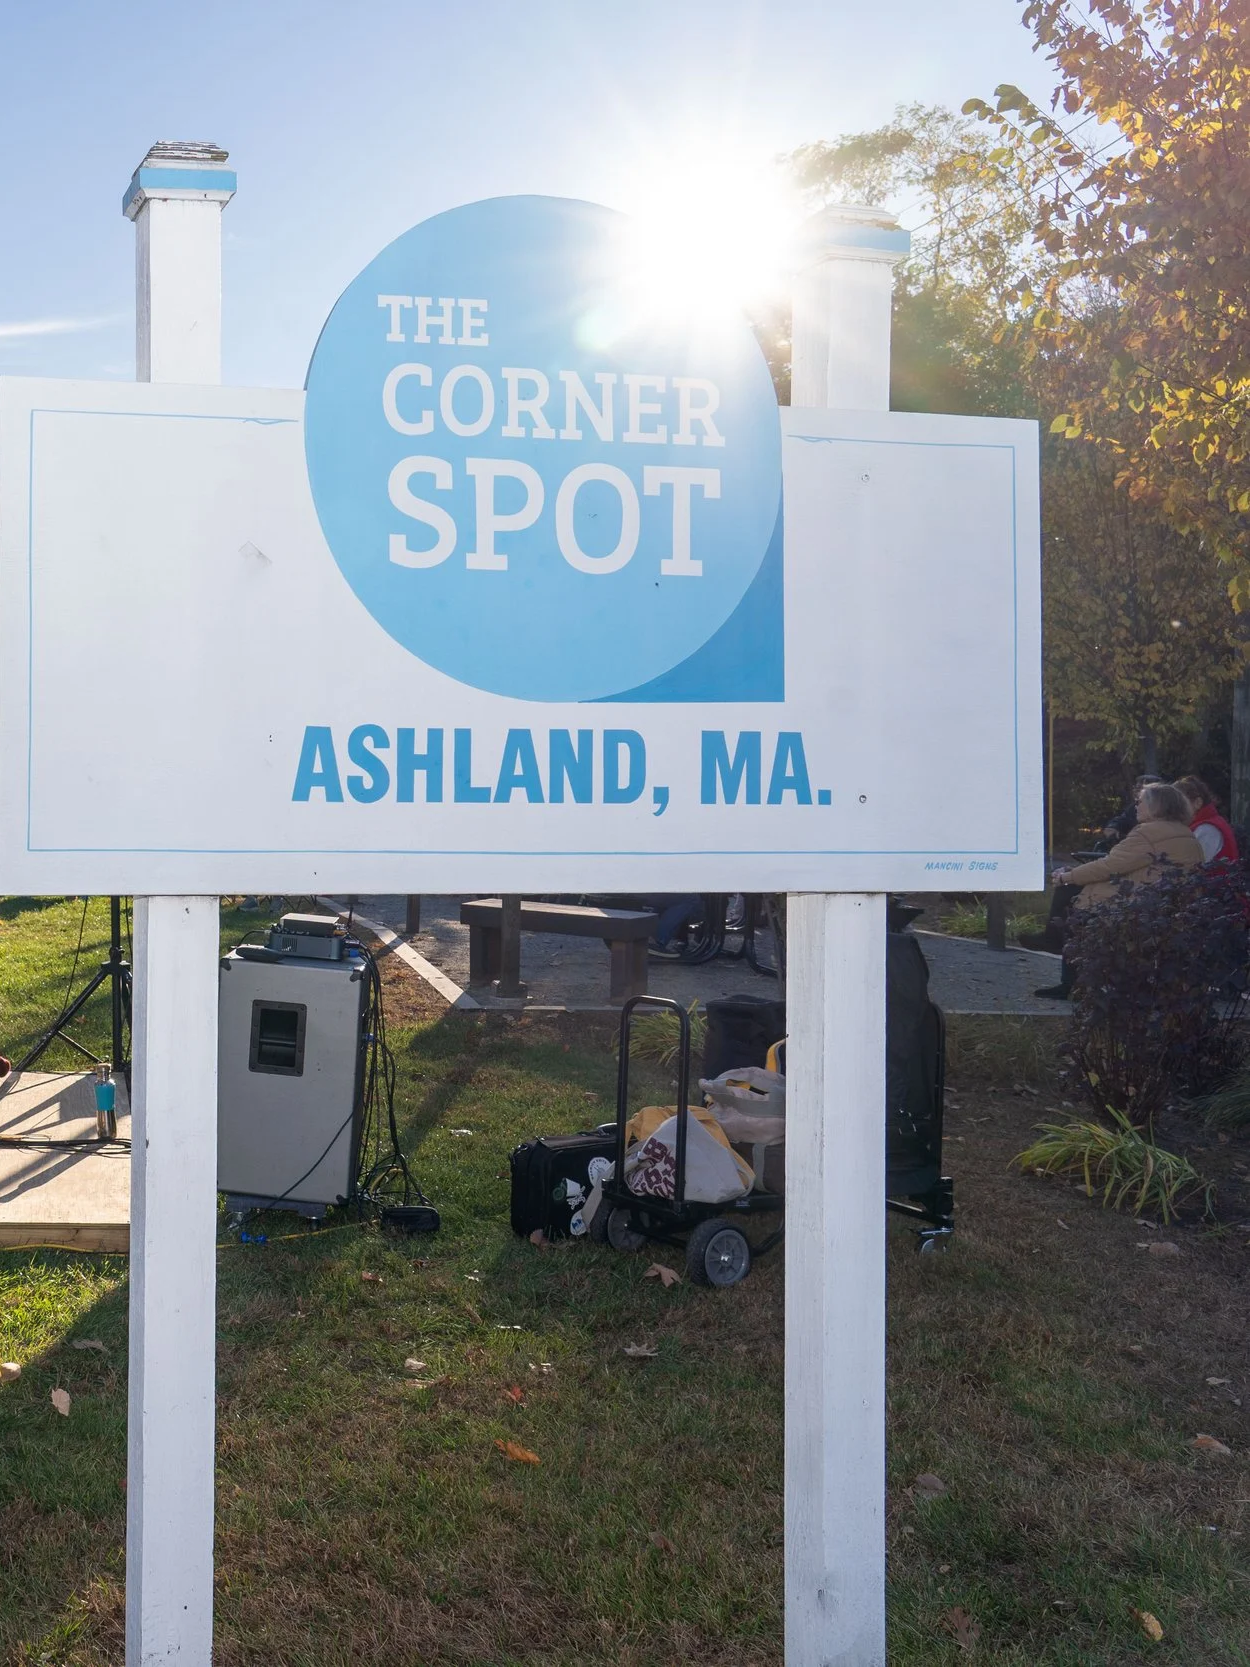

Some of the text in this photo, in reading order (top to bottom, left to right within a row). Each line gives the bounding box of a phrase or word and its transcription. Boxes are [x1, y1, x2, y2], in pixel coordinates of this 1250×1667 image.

[377, 294, 489, 347] THE
[382, 362, 726, 448] CORNER
[387, 455, 722, 577] SPOT
[291, 724, 832, 817] ASHLAND, MA.
[924, 860, 999, 872] MANCINI SIGNS
